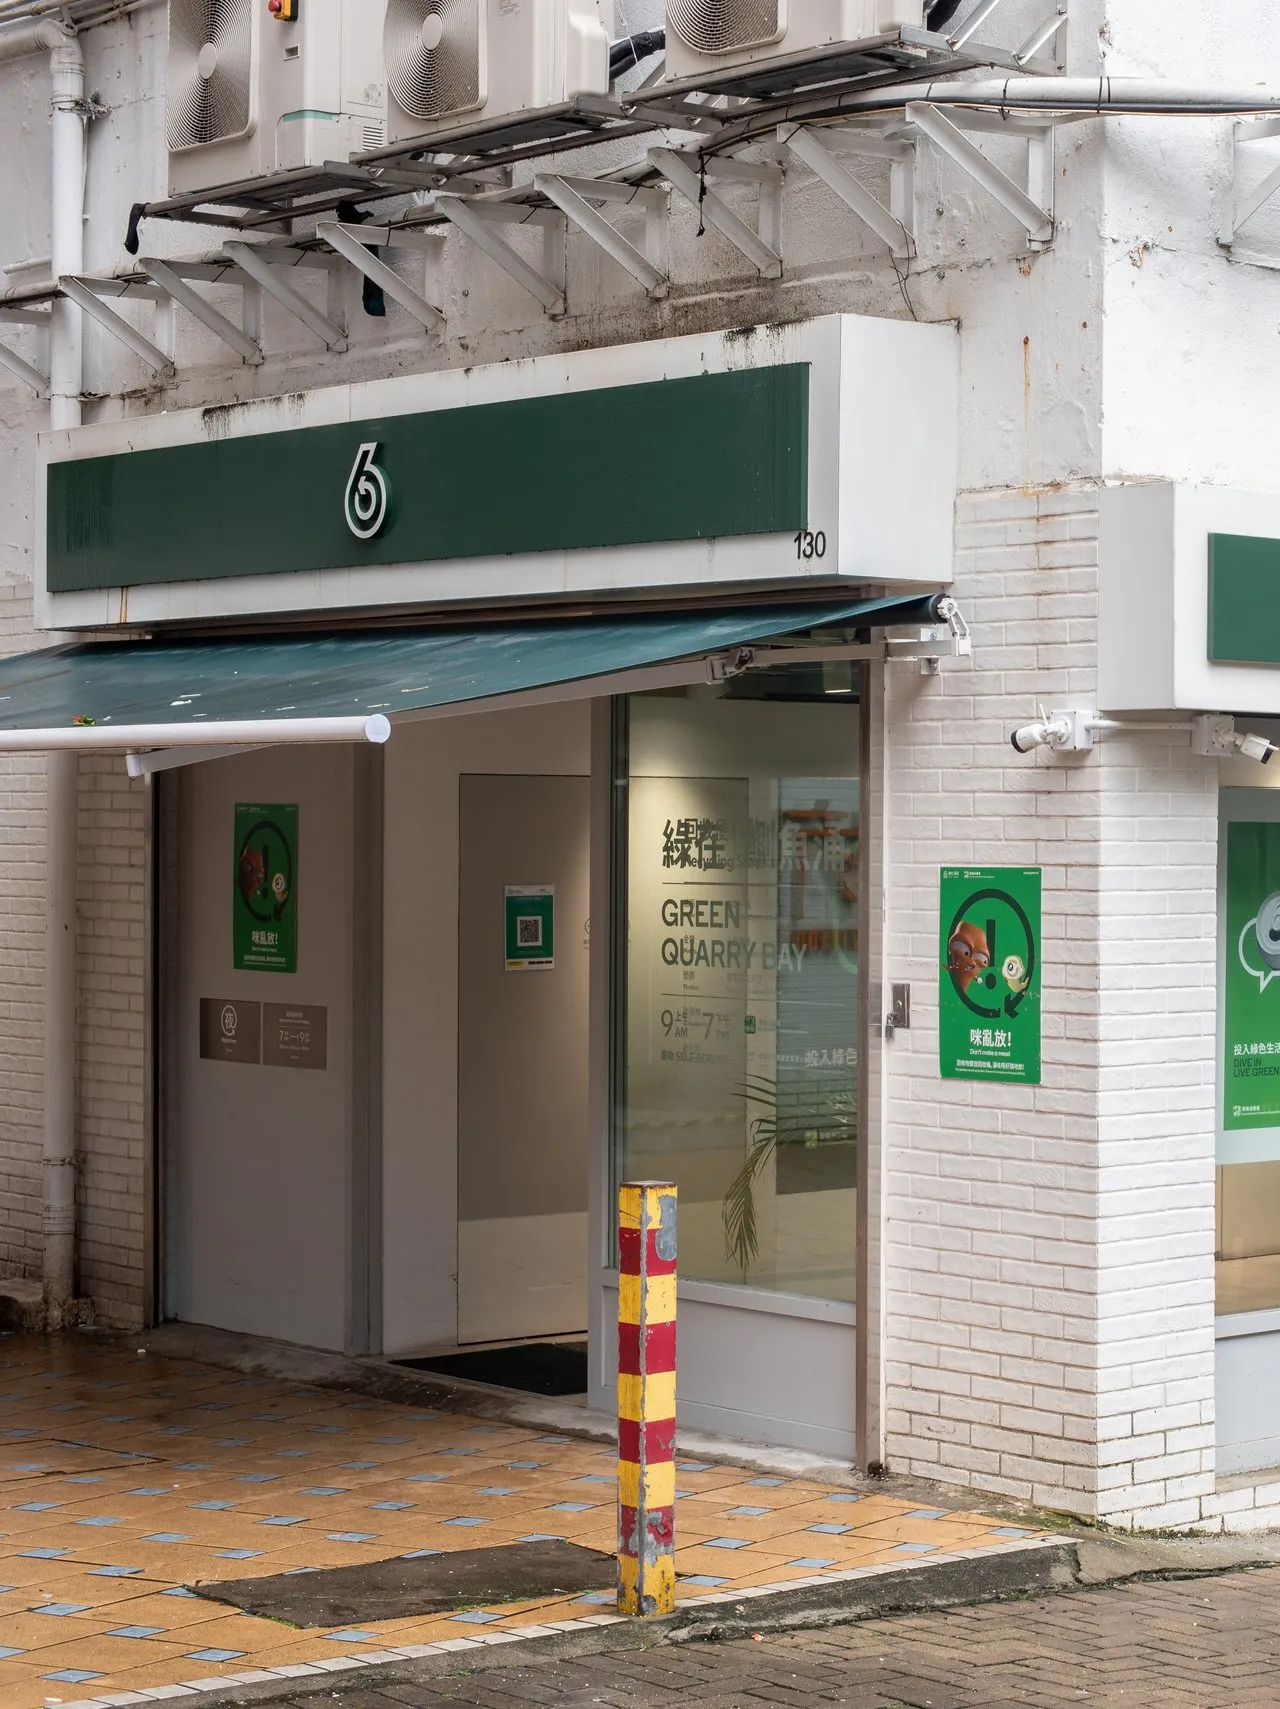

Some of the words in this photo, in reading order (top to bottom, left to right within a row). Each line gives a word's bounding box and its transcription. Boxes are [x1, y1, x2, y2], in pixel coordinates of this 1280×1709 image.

[794, 530, 826, 559] 130
[661, 898, 741, 929] GREEN
[661, 937, 756, 970] QUARRY
[762, 942, 808, 972] BAY
[661, 1009, 673, 1037] 9
[674, 1027, 688, 1038] AM
[702, 1012, 714, 1040] 7
[970, 1028, 1012, 1048] 咪亂放!
[804, 1047, 858, 1067] 投入綠色
[1233, 1058, 1252, 1067] DIVE
[1253, 1057, 1262, 1066] IN
[1233, 1068, 1251, 1078] LIVE
